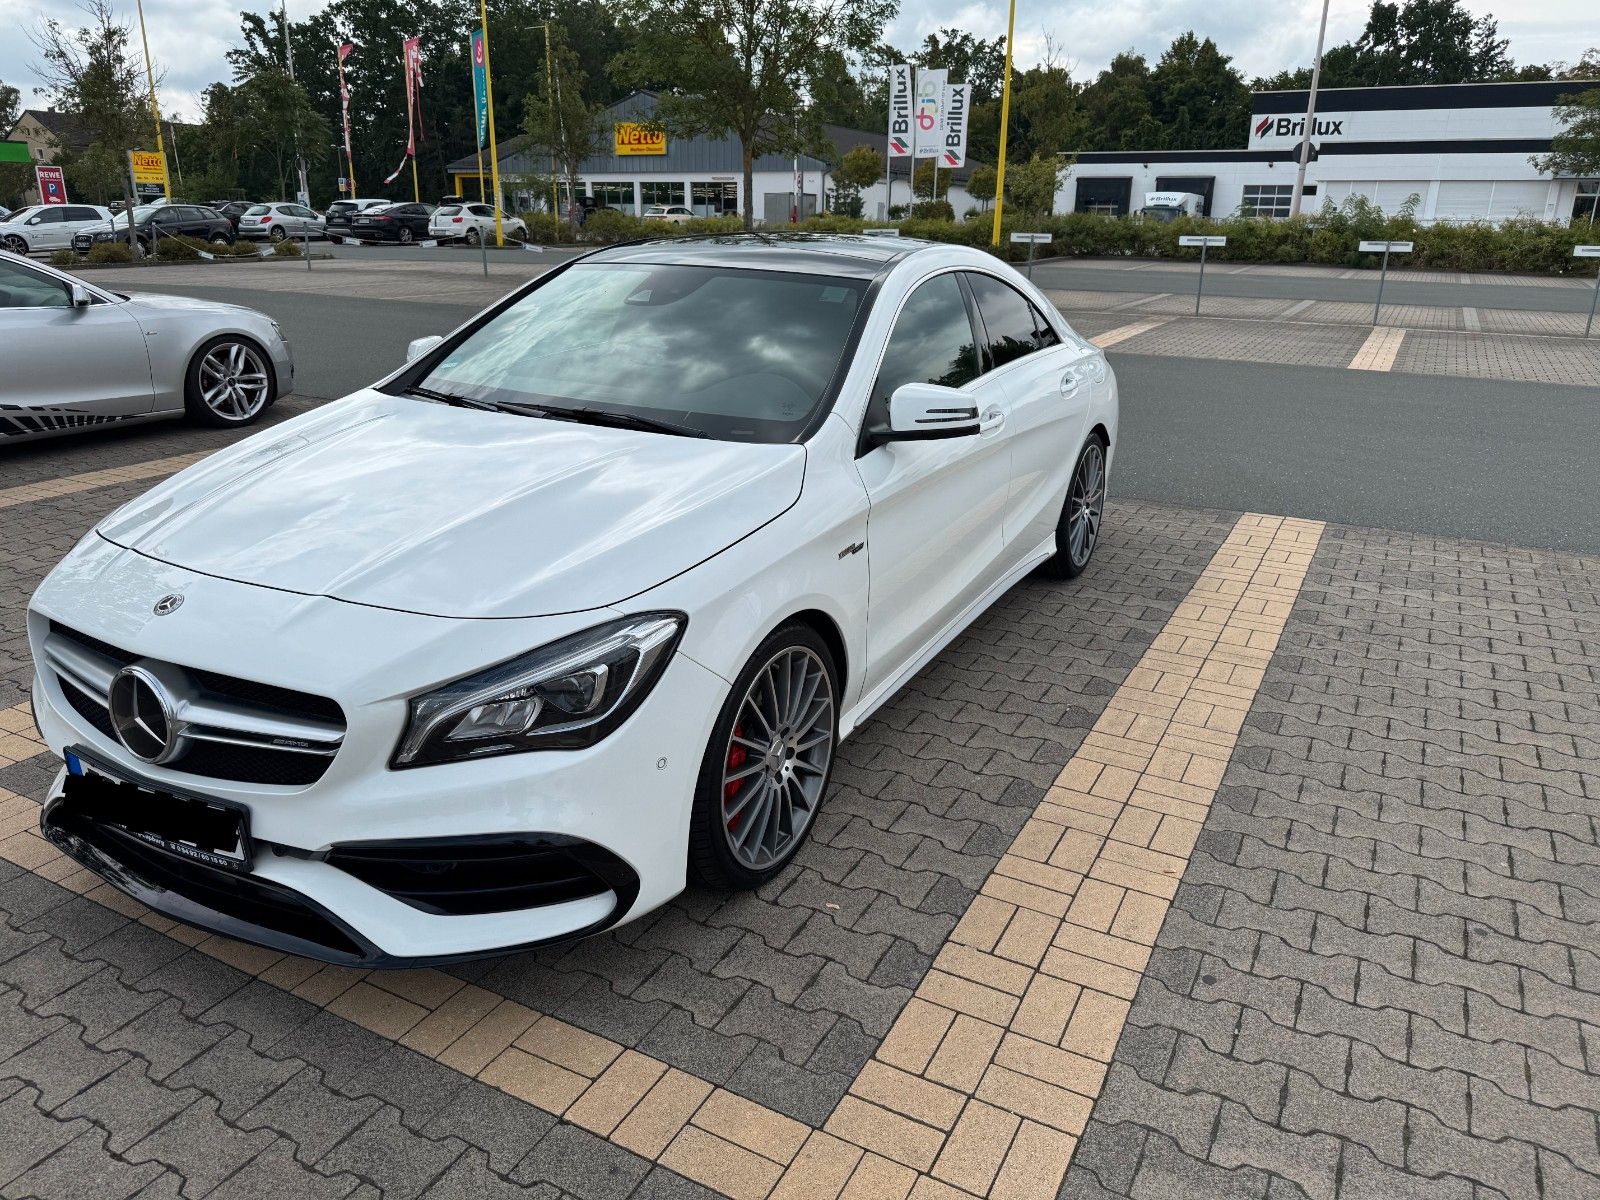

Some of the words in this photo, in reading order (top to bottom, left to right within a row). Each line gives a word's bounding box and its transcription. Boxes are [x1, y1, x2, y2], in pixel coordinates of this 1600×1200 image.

[892, 68, 909, 134] Brillux
[945, 87, 965, 147] Brillux
[617, 126, 664, 145] Netto
[1275, 118, 1343, 136] Brilux
[39, 171, 61, 179] REWE
[48, 183, 56, 193] P
